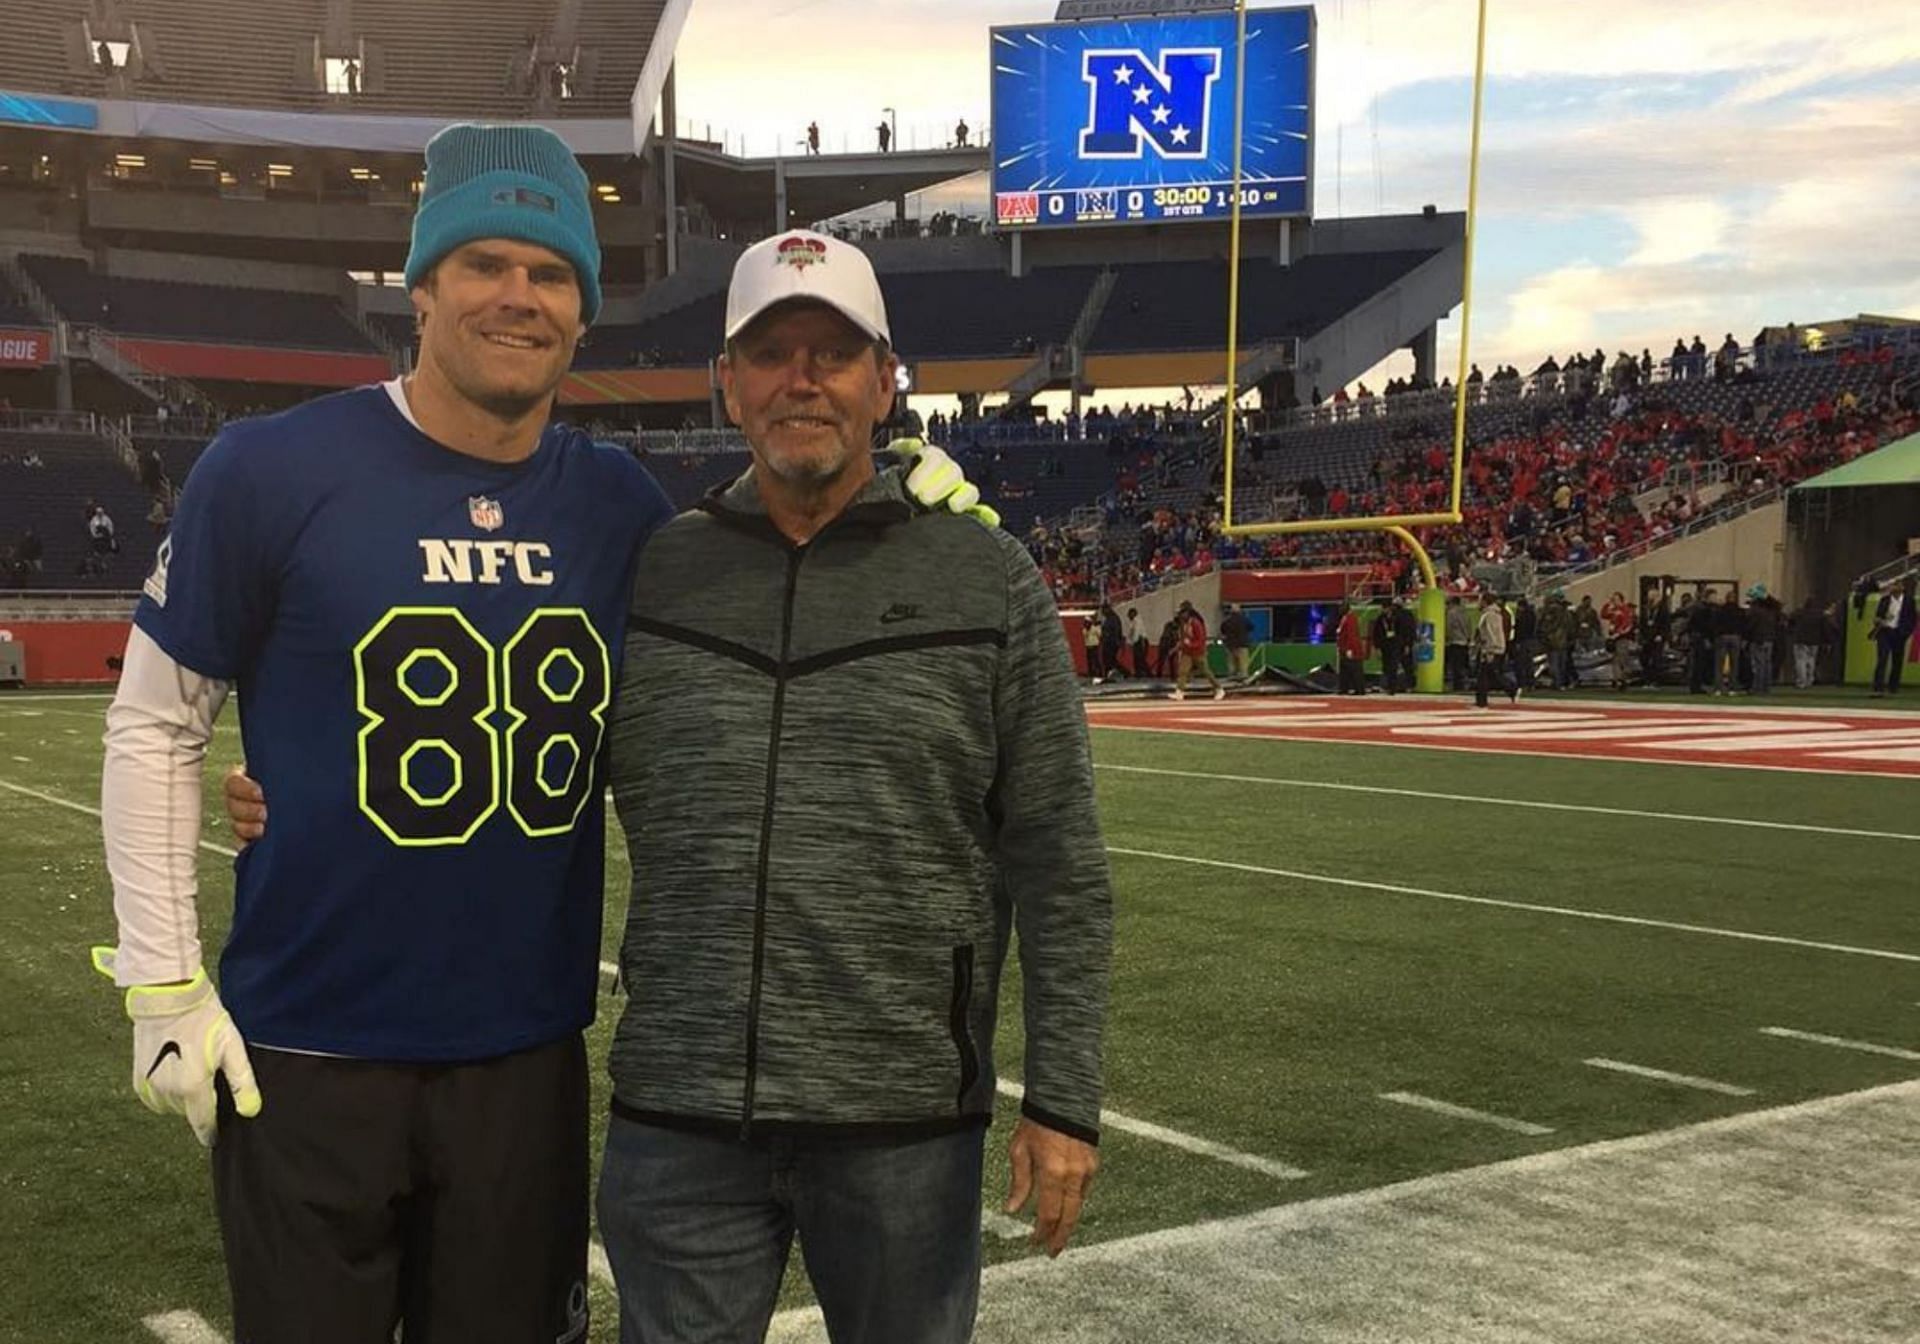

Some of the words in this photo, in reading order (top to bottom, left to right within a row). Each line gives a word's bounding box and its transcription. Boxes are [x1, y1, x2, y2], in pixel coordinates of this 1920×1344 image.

[1048, 195, 1064, 215] 0
[1127, 191, 1144, 211] 0
[1153, 186, 1211, 206] 30:00
[0, 339, 37, 360] GUE
[418, 539, 554, 585] NFC
[353, 606, 611, 846] 88
